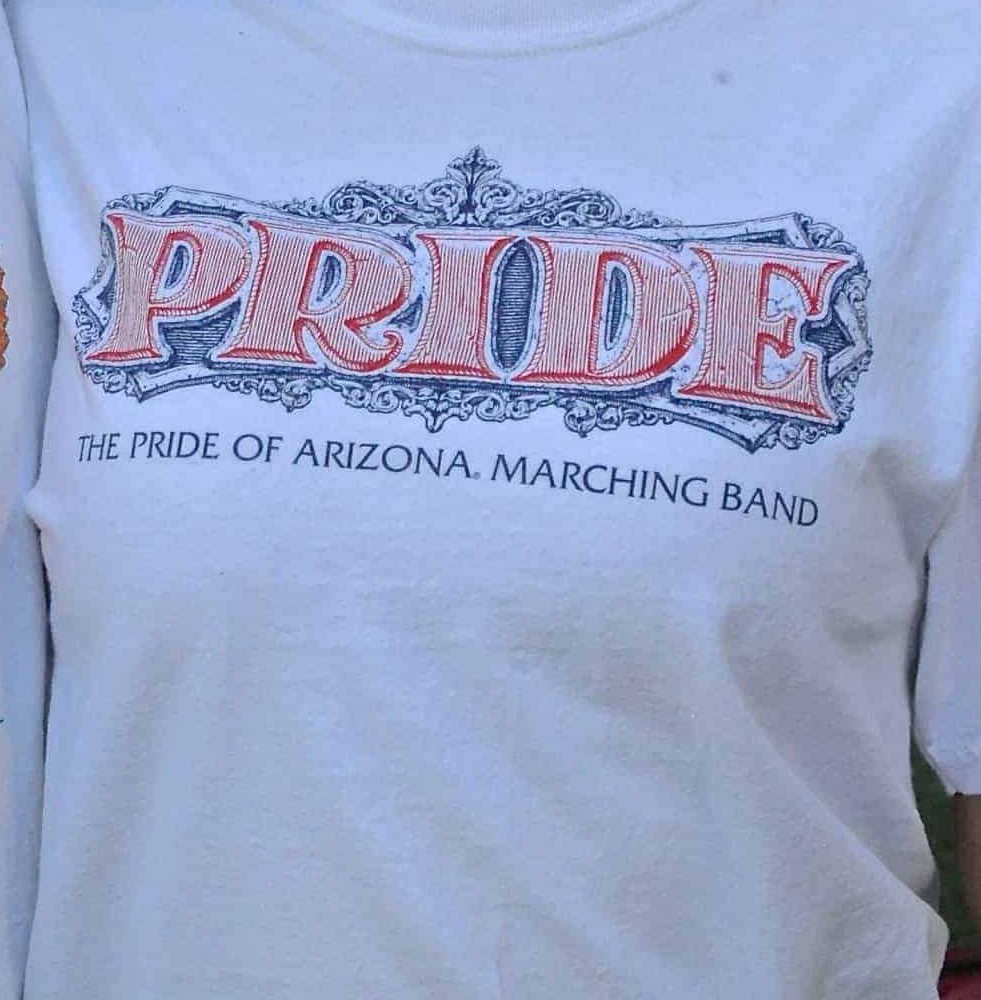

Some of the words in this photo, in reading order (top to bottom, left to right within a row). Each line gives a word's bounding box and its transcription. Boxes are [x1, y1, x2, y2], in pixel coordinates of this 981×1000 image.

[82, 211, 856, 424] PRIDE
[78, 434, 121, 462] THE
[130, 431, 220, 460] PRIDE
[233, 433, 283, 463] OF
[490, 454, 709, 508] MARCHING
[721, 482, 819, 527] BAND
